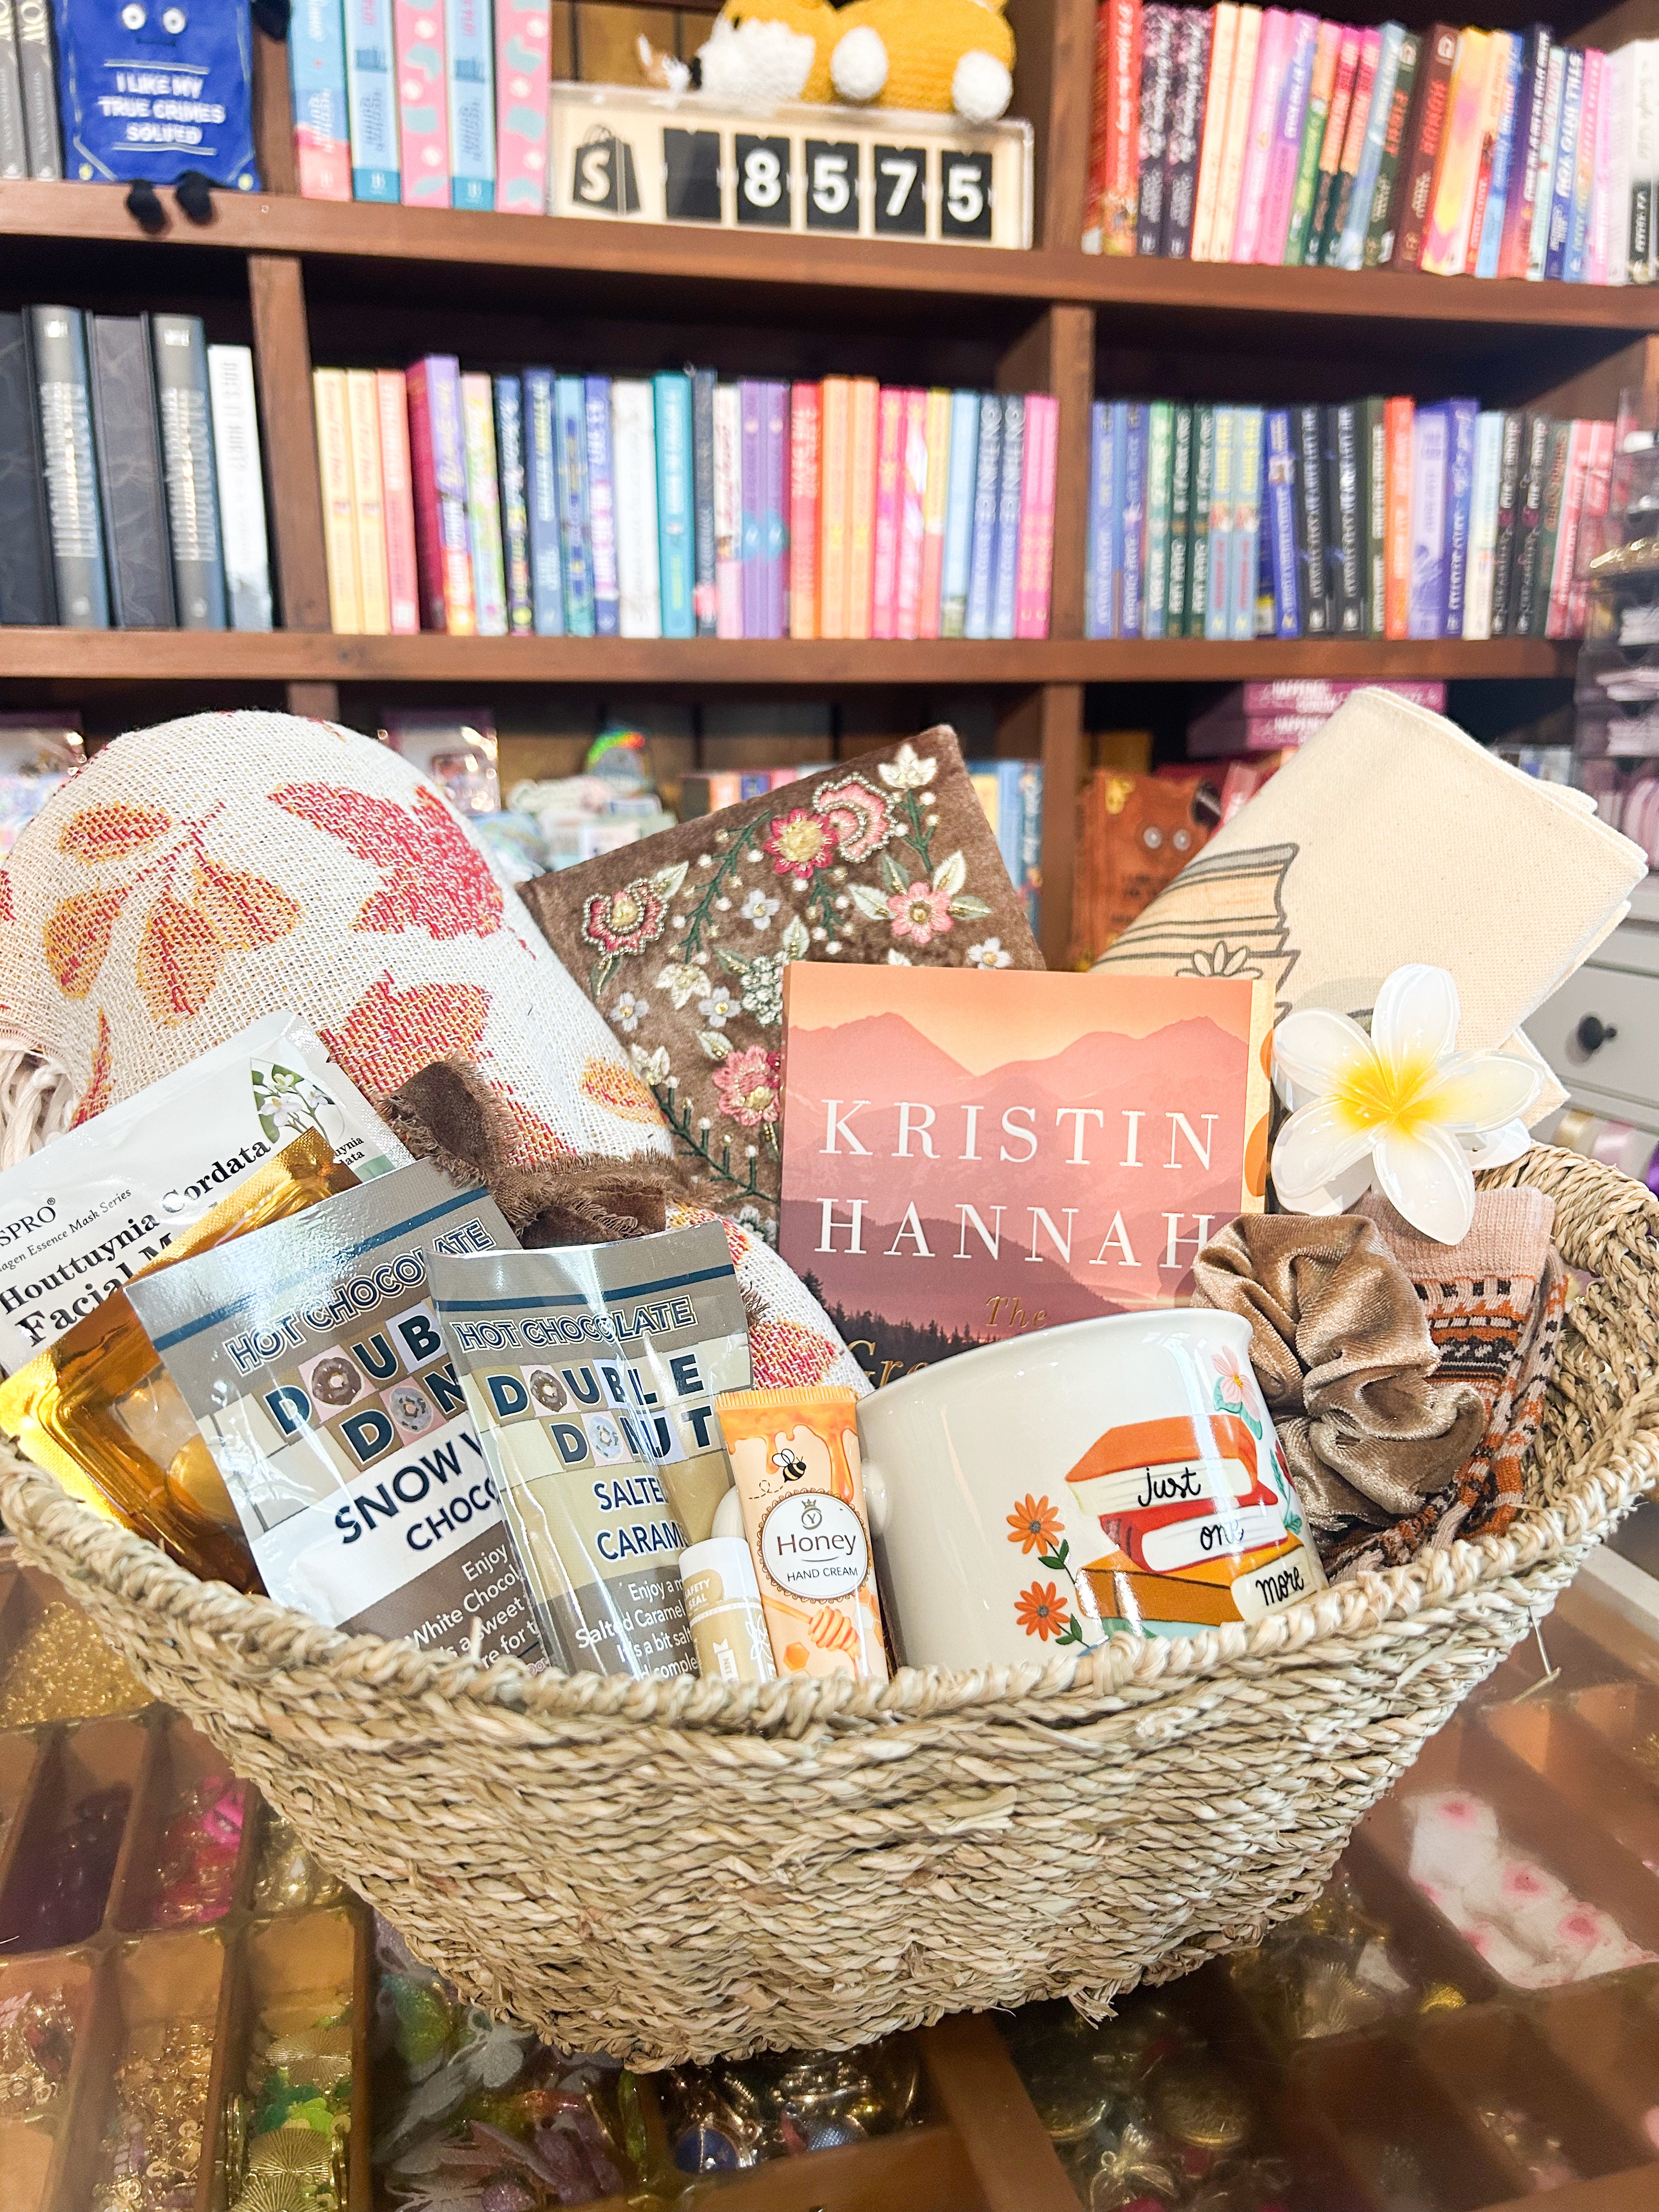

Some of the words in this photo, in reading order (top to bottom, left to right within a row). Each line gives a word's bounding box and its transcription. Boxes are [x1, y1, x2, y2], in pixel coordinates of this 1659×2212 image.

[127, 71, 171, 95] LIKE
[1565, 53, 1583, 101] STILL
[98, 96, 151, 117] TRUE
[152, 99, 226, 124] CRIMES
[1554, 154, 1575, 199] YOU
[819, 1098, 1219, 1171] KRISTIN
[0, 1214, 160, 1315] Houttuynia
[162, 1139, 271, 1213] Cordata
[27, 1231, 69, 1256] Essence
[69, 1209, 100, 1233] Mask
[100, 1189, 132, 1213] Series
[814, 1197, 1215, 1268] HANNAH
[450, 1319, 523, 1353] HOT
[518, 1294, 698, 1348] CHOCOLATE
[986, 1295, 1048, 1329] The
[223, 1311, 307, 1378] HOT
[335, 1440, 462, 1545] SNOW
[592, 1475, 670, 1514] SALTE
[1138, 1467, 1201, 1507] just
[596, 1520, 693, 1564] CARAM
[777, 1533, 856, 1555] Honey
[1200, 1519, 1244, 1550] one
[461, 1543, 509, 1582] Enjoy
[787, 1568, 820, 1582] HAND
[822, 1566, 858, 1577] CREAM
[628, 1578, 665, 1604] Enjoy
[666, 1581, 674, 1592] a
[685, 1578, 710, 1600] SAFETY
[689, 1593, 707, 1610] SEAL
[1255, 1566, 1305, 1606] more
[406, 1609, 465, 1649] White
[463, 1564, 521, 1613] Chocol
[634, 1600, 686, 1628] Caramel
[501, 1629, 526, 1656] for
[644, 1641, 653, 1654] a
[654, 1631, 673, 1650] bit
[674, 1626, 694, 1646] salt
[653, 1653, 701, 1682] comple
[723, 1657, 732, 1674] NET
